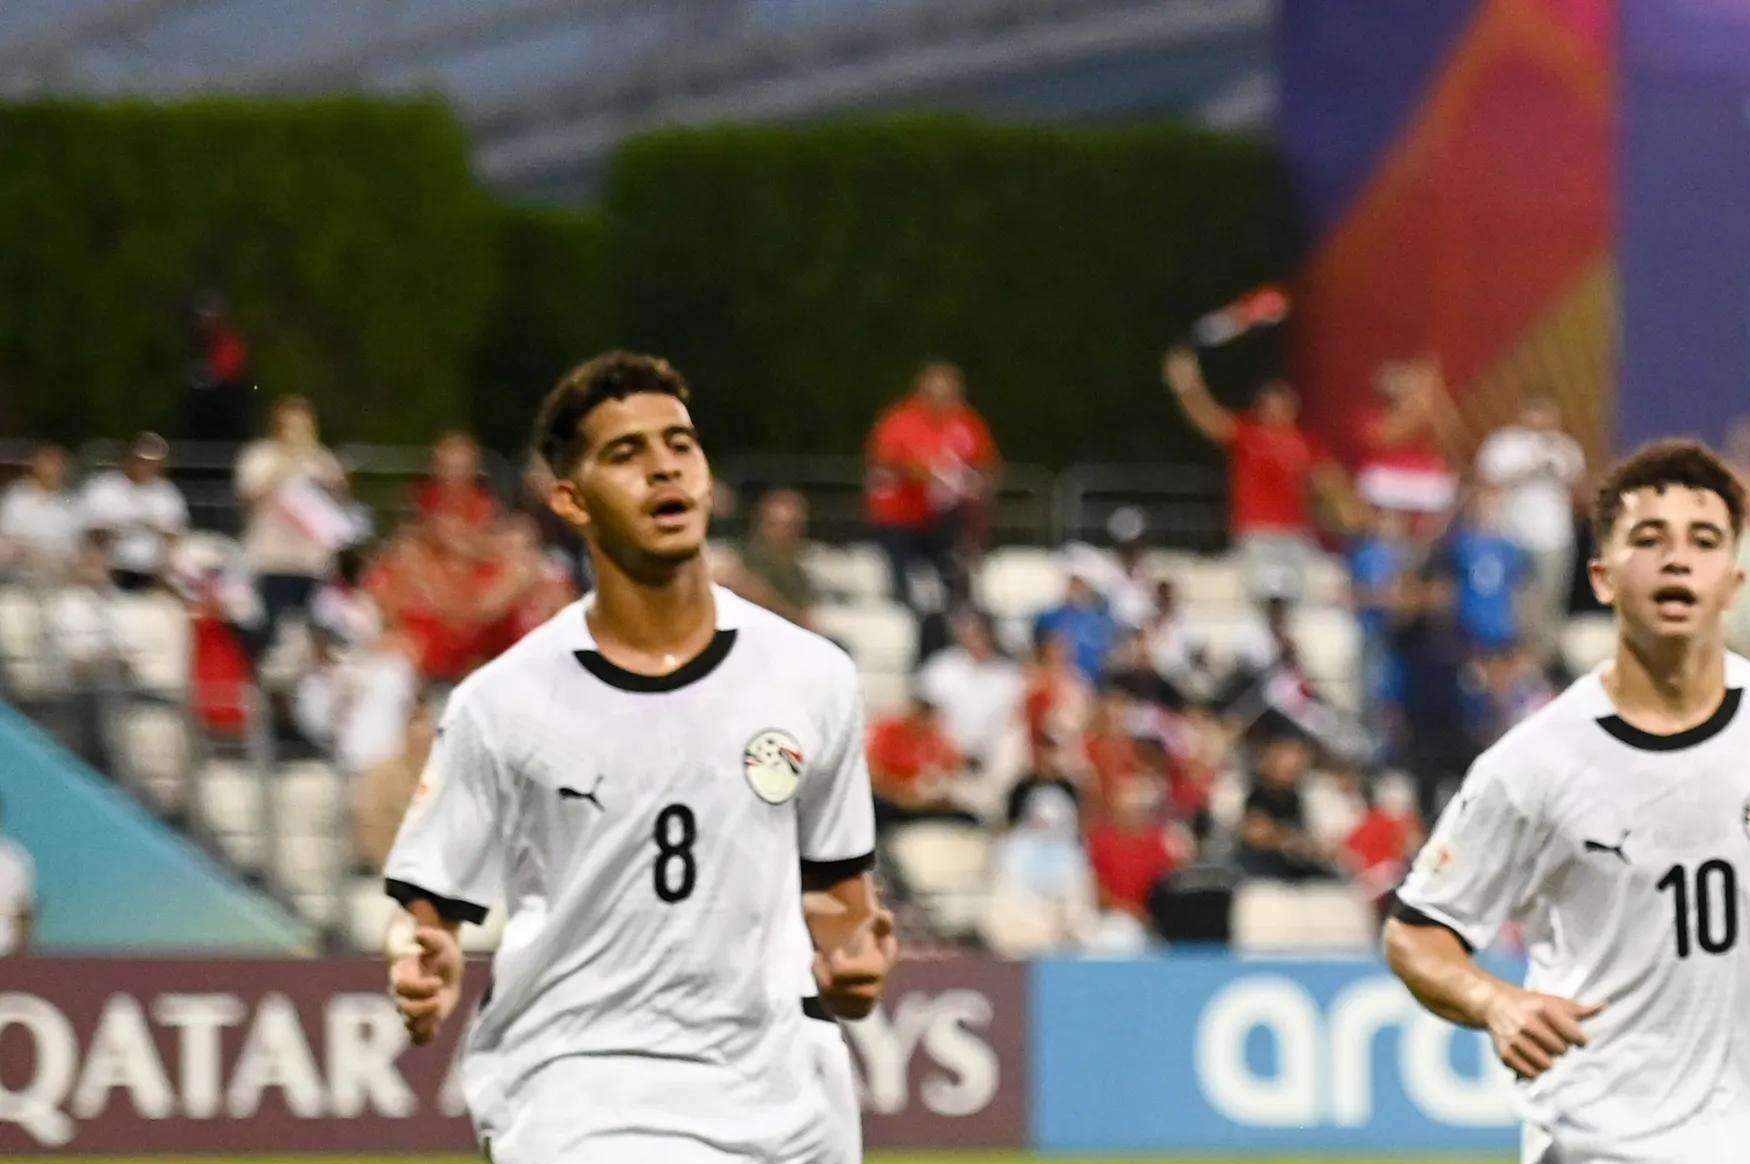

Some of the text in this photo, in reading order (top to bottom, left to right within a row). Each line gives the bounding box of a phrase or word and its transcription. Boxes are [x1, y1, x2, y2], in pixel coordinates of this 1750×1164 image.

[654, 803, 697, 904] 8
[1656, 859, 1738, 958] 10
[0, 993, 416, 1146] QATAR
